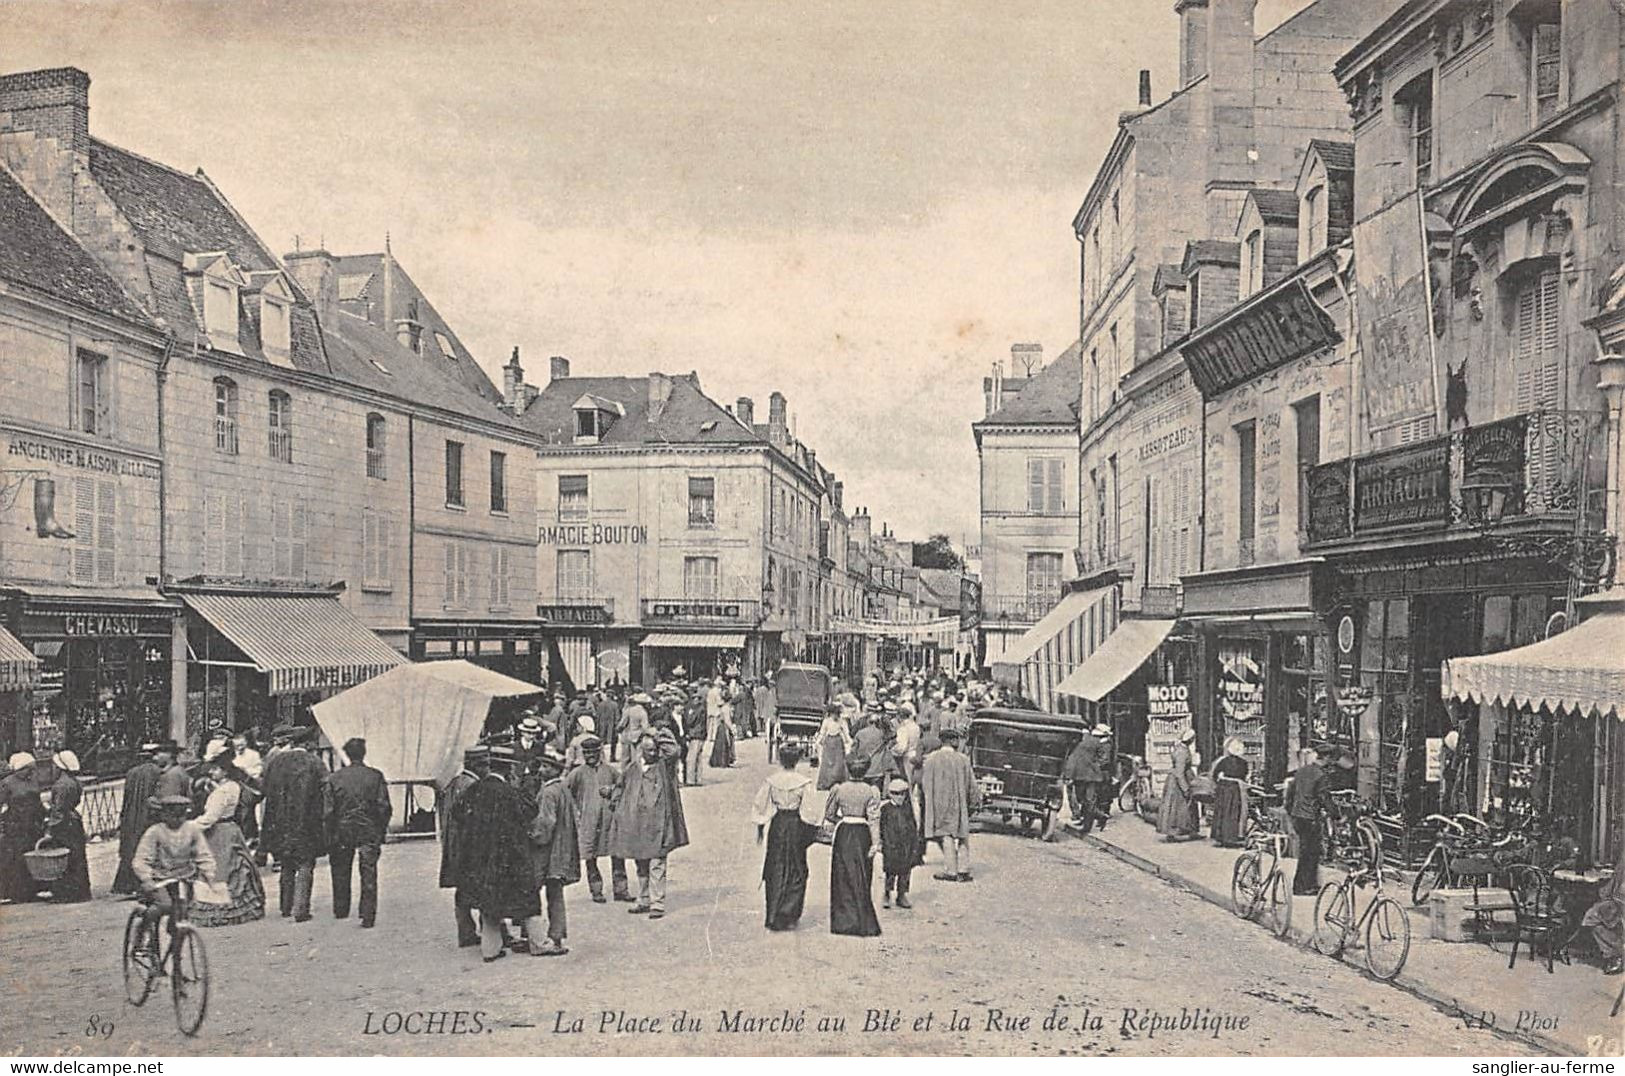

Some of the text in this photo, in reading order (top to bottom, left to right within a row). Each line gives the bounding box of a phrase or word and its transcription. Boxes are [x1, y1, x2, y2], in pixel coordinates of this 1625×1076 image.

[1184, 297, 1325, 396] AUTOMOBILES
[8, 440, 73, 465] ANCIENNE
[75, 449, 118, 474] MAISON
[592, 523, 647, 544] BOUTON
[65, 616, 138, 634] CHEVASSU
[1148, 685, 1188, 701] MOTO
[1150, 701, 1189, 714] NAPHTA
